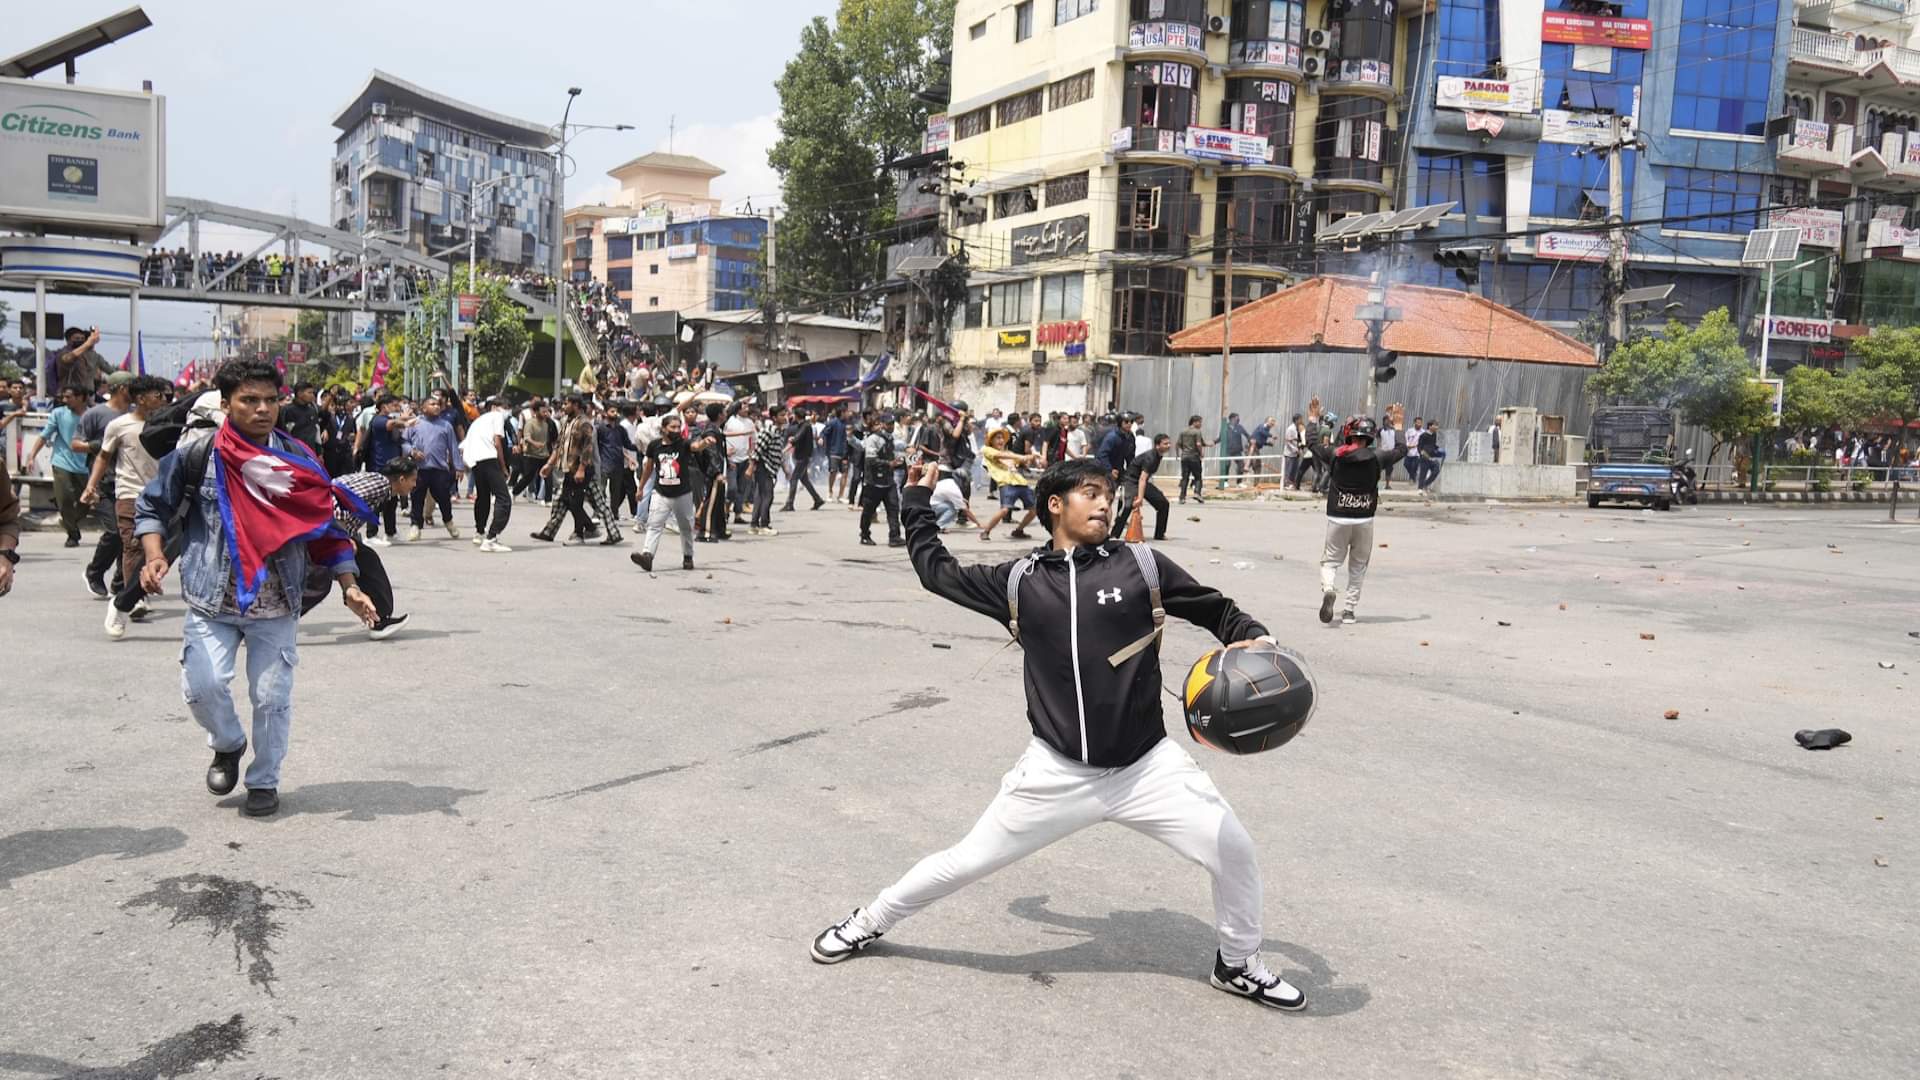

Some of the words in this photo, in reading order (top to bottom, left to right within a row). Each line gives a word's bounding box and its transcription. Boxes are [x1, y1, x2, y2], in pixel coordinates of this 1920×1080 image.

[1168, 24, 1185, 34] IELTS
[1146, 32, 1163, 45] USA
[1168, 34, 1185, 45] PTE
[1187, 35, 1199, 48] UK
[1464, 81, 1509, 94] PASSION
[1, 112, 102, 140] Citizens
[107, 128, 141, 140] Bank
[1206, 134, 1232, 144] STUDY
[66, 157, 96, 167] BANKER
[1037, 320, 1088, 344] AMIGO
[1776, 320, 1828, 338] GORETO
